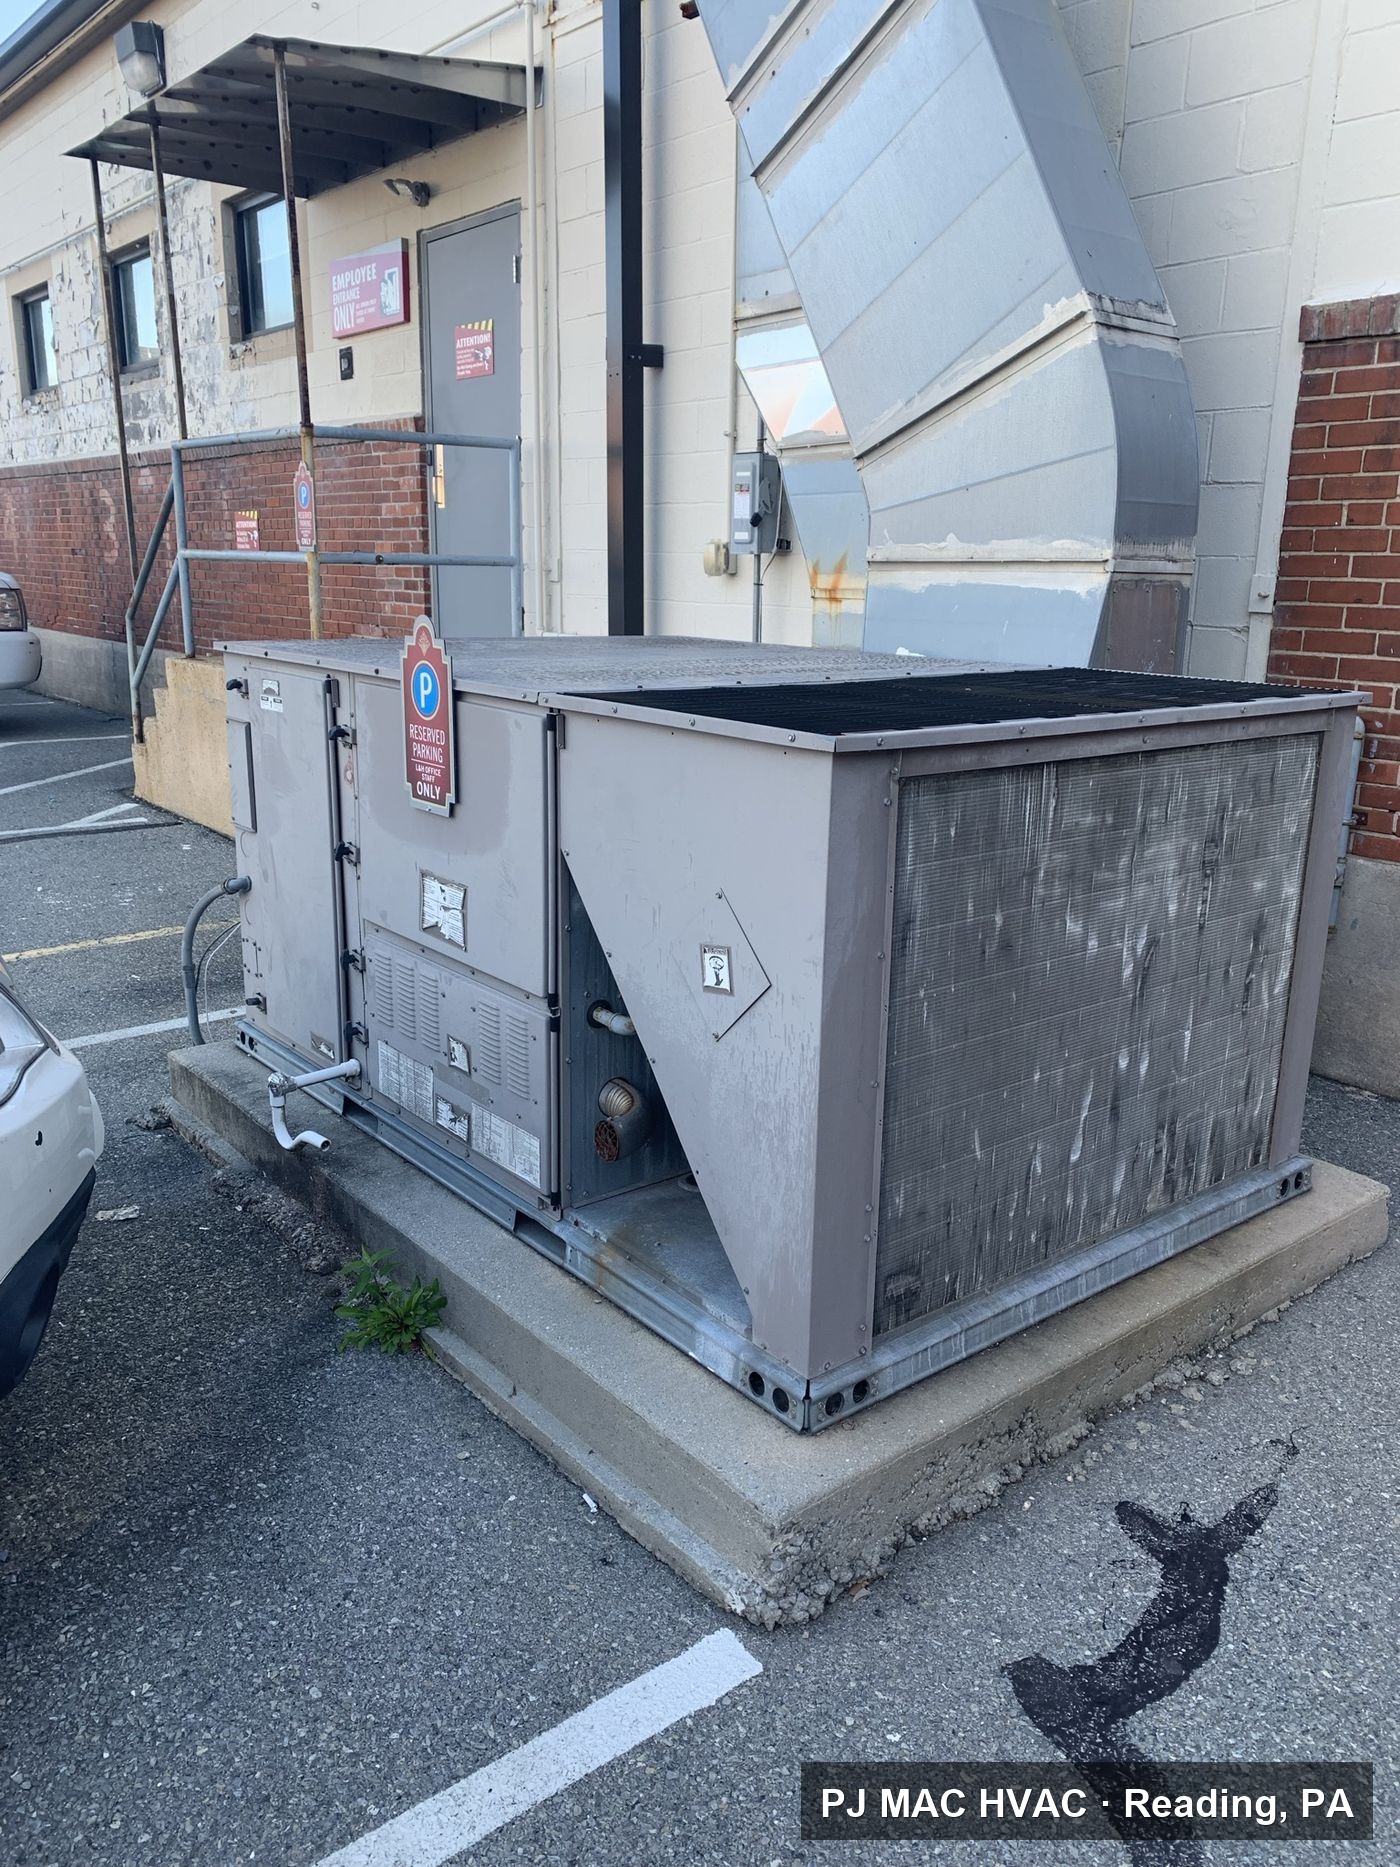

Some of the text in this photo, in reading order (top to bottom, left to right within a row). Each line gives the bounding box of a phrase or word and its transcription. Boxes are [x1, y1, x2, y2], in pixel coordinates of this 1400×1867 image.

[332, 263, 377, 292] EMPLOYEE
[333, 286, 360, 305] ENTRANCE
[334, 302, 355, 331] ONLY
[456, 332, 491, 349] ATTENTION!
[301, 486, 307, 504] P
[419, 671, 432, 708] P
[409, 723, 445, 745] RESERVED
[412, 742, 443, 763] PARKING
[415, 763, 441, 777] L&H OFFICE
[421, 774, 435, 783] STAFF
[416, 781, 441, 800] ONLY
